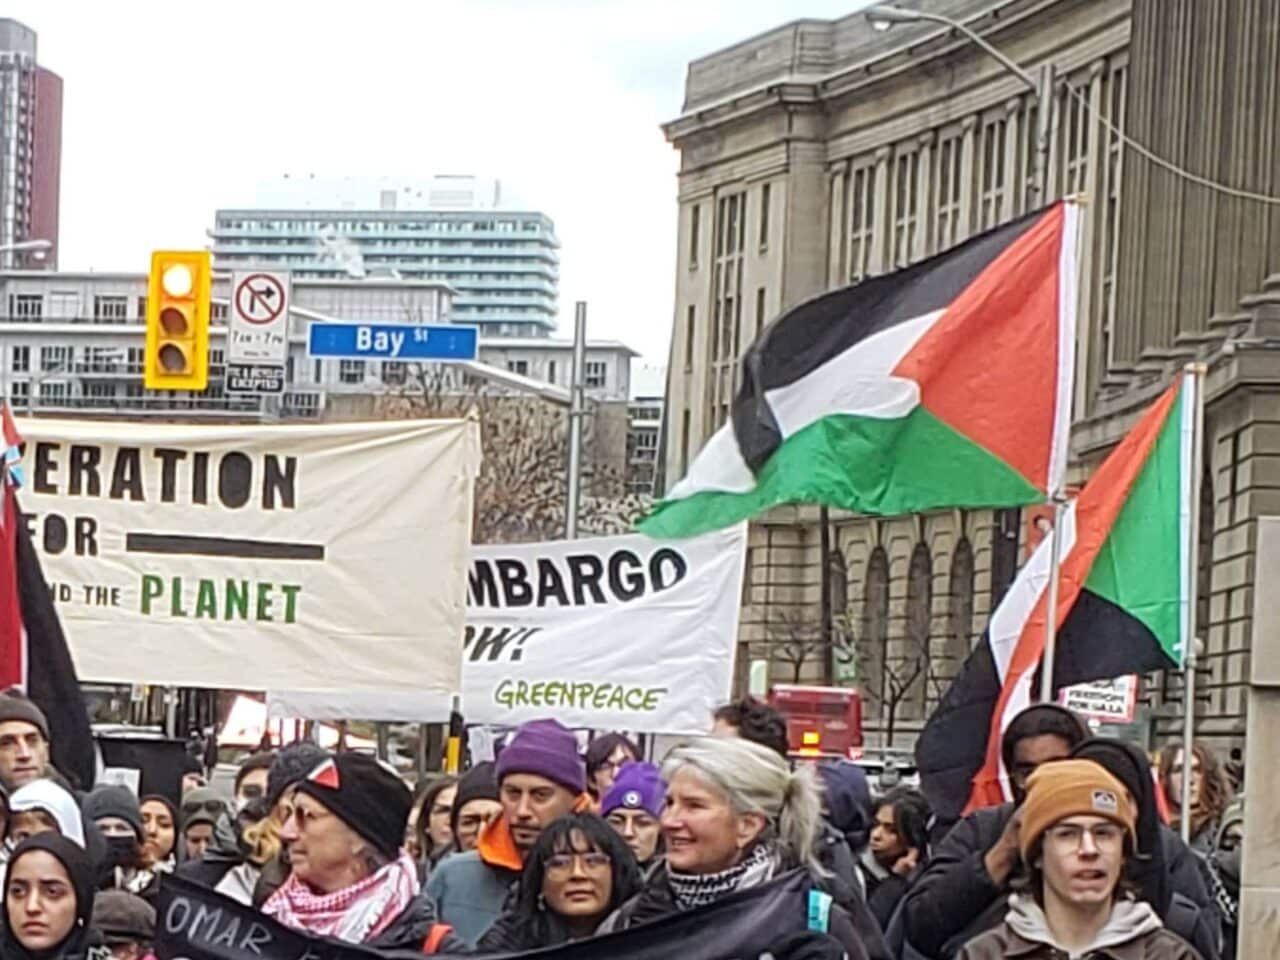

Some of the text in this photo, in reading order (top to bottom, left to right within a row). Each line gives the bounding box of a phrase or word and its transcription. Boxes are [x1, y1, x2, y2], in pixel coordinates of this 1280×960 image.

[356, 327, 404, 357] Bay
[414, 328, 428, 343] St
[83, 585, 121, 606] THE
[141, 575, 302, 624] PLANET
[494, 680, 668, 711] GREENPEACE
[166, 898, 271, 955] OMAR
